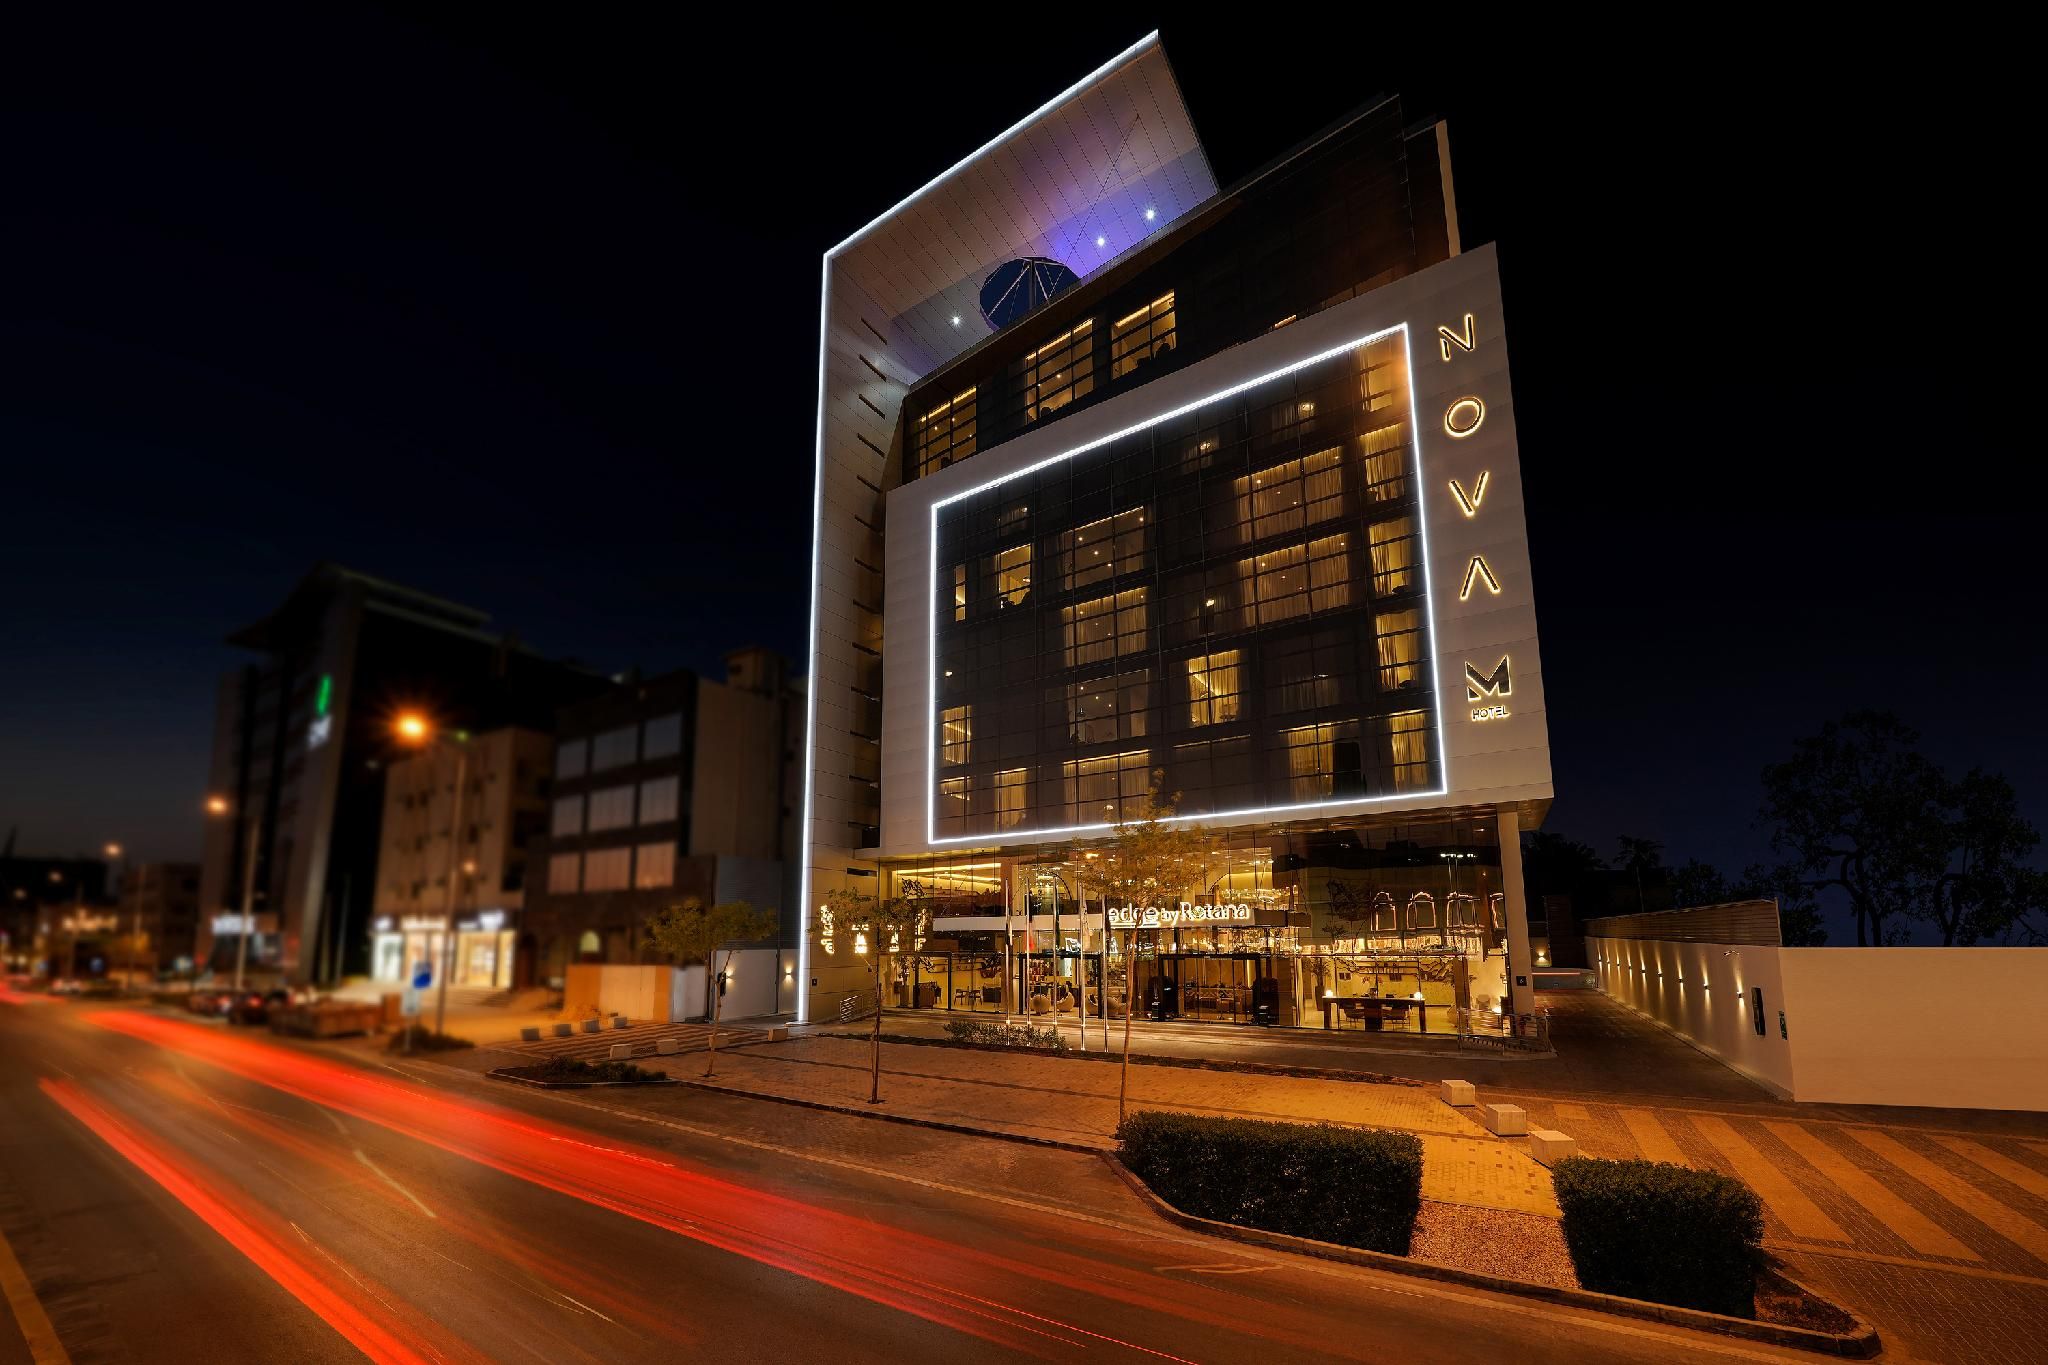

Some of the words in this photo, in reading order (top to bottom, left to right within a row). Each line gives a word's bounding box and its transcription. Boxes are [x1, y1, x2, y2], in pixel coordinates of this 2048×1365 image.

[1471, 705, 1512, 722] HOTEL
[1160, 907, 1178, 926] by
[1179, 901, 1250, 921] Rotana
